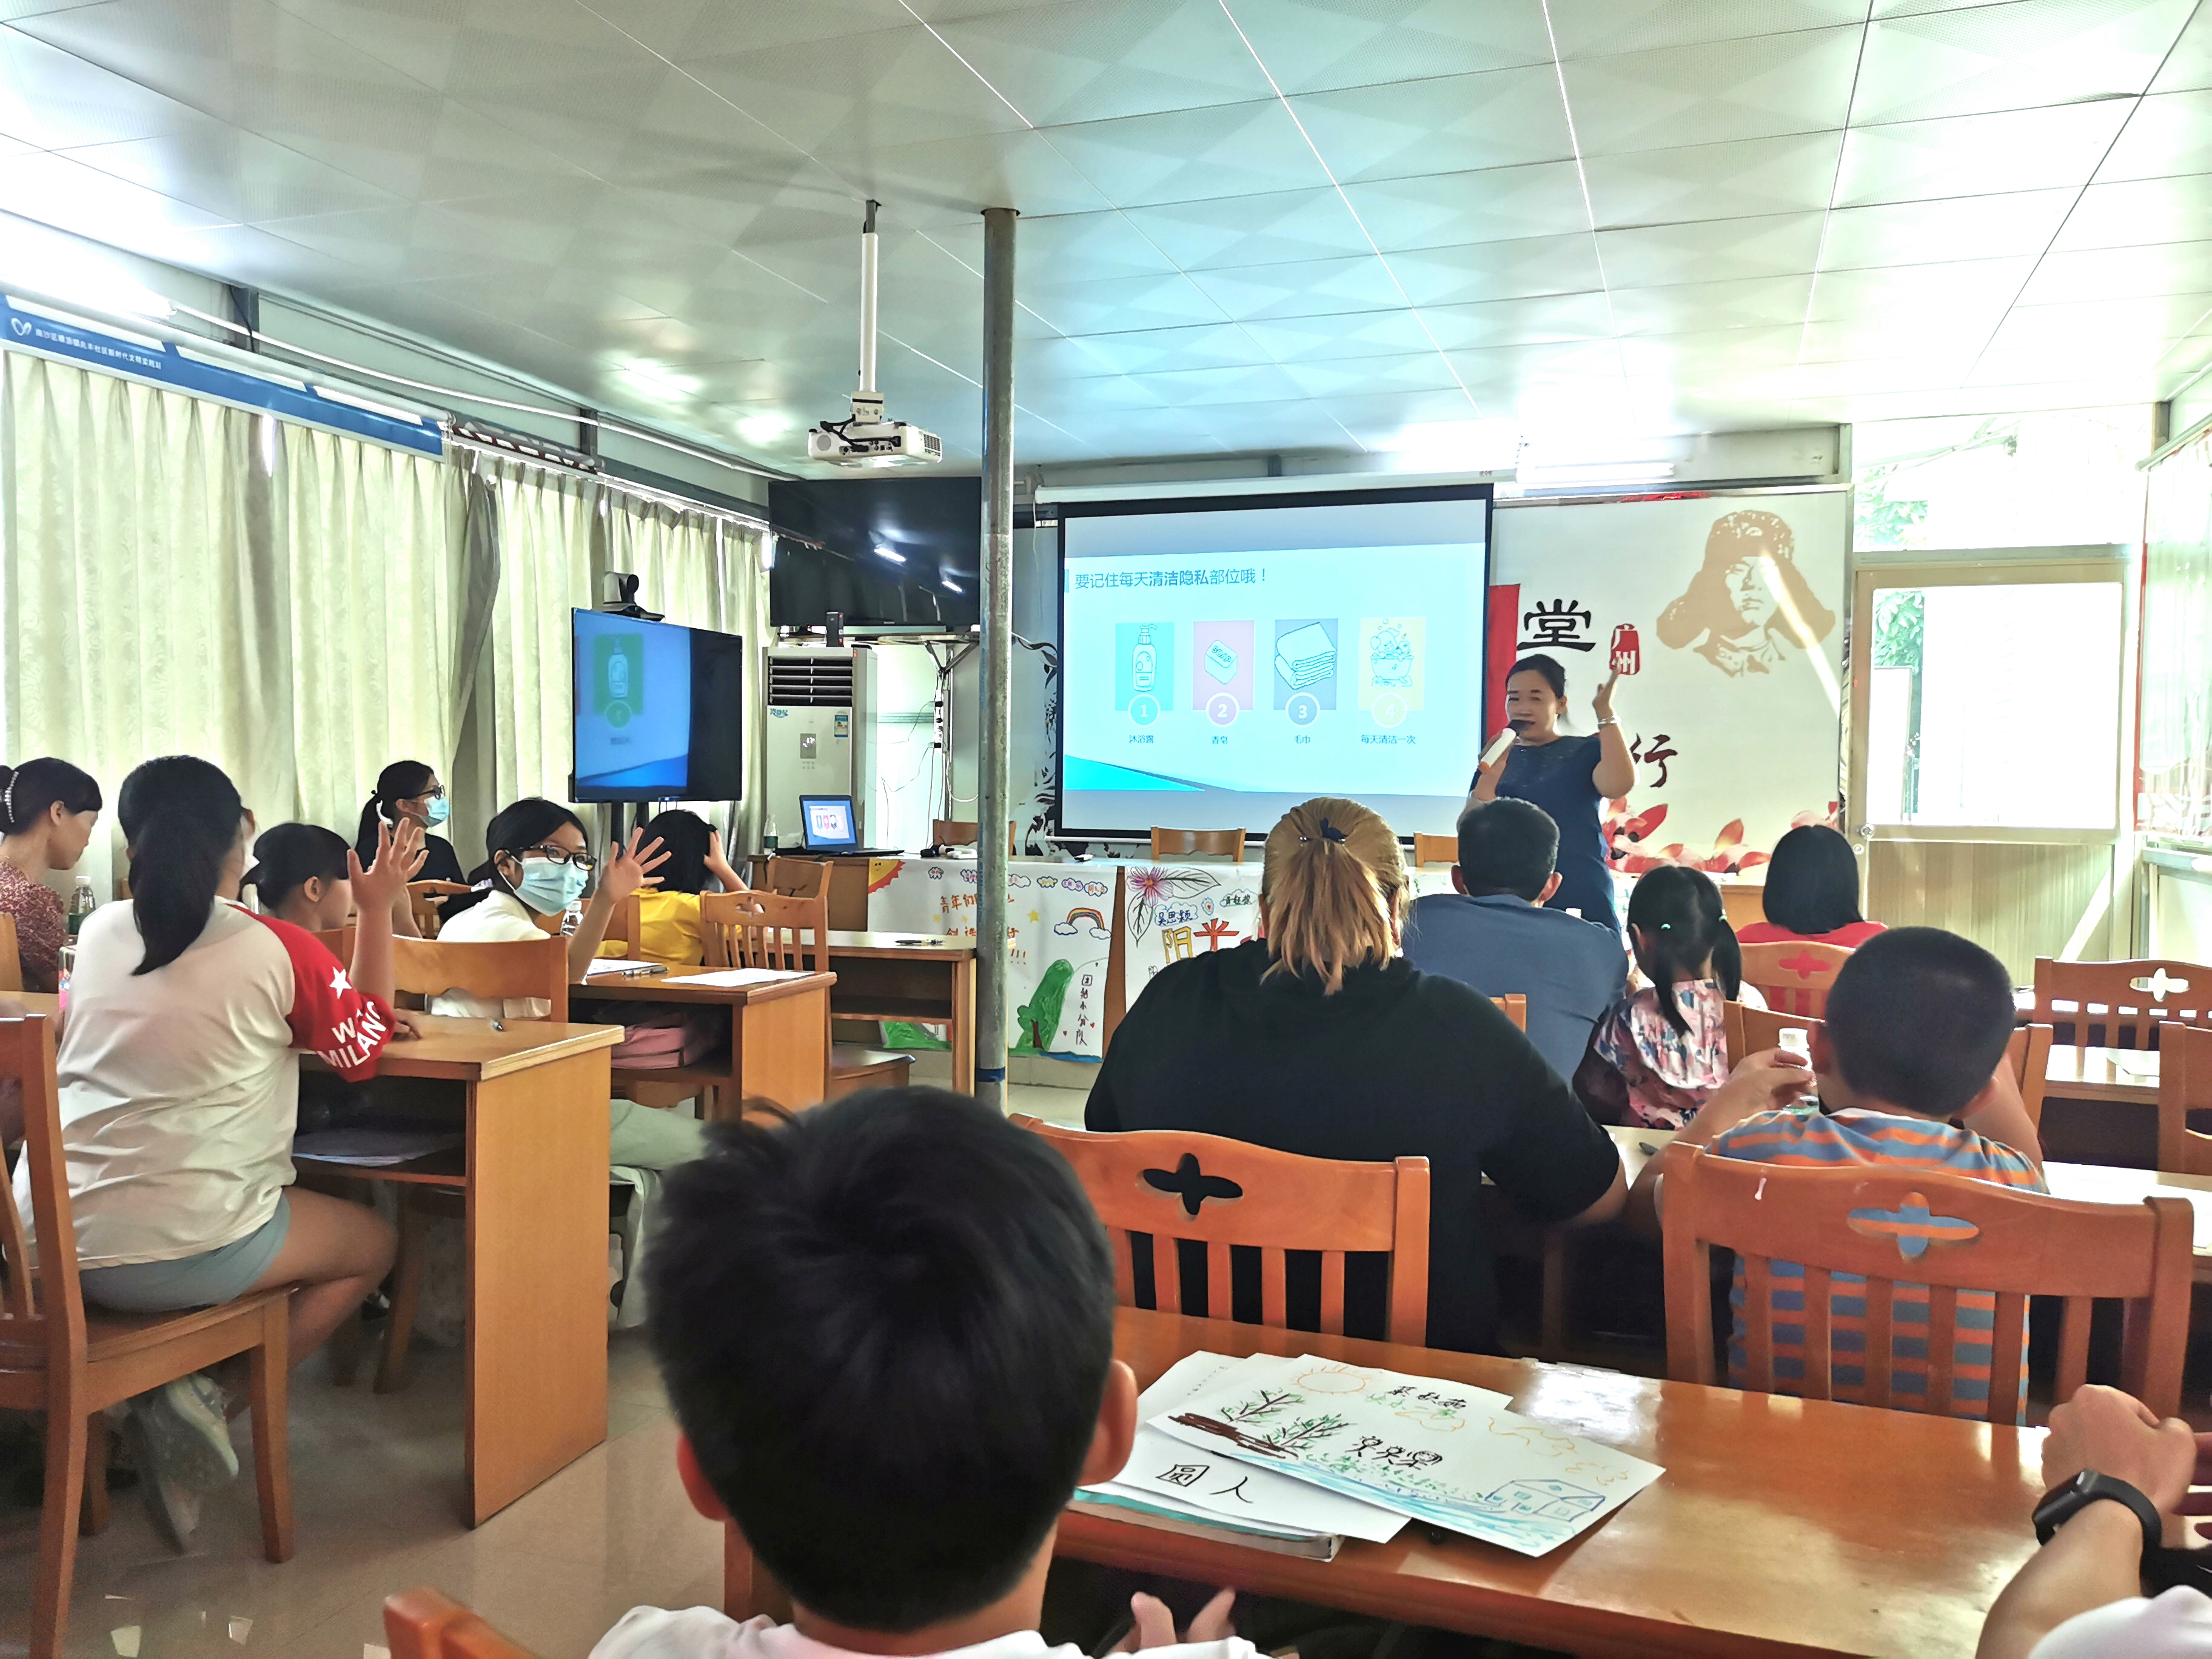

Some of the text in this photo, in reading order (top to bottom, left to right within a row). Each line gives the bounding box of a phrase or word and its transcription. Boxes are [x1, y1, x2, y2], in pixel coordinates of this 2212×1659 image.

[1075, 568, 1265, 589] 要记住每天清洁隐私部位哦！
[1517, 598, 1596, 651] 堂
[1212, 645, 1232, 662] SOAP
[1140, 704, 1148, 717] 1
[1218, 703, 1227, 718] 2
[1298, 705, 1307, 719] 3
[1386, 703, 1396, 718] 4
[1128, 734, 1154, 744] 沐浴露
[1212, 736, 1228, 745] 香皂
[1293, 735, 1311, 745] 毛巾
[1361, 734, 1416, 745] 每天清洁一次
